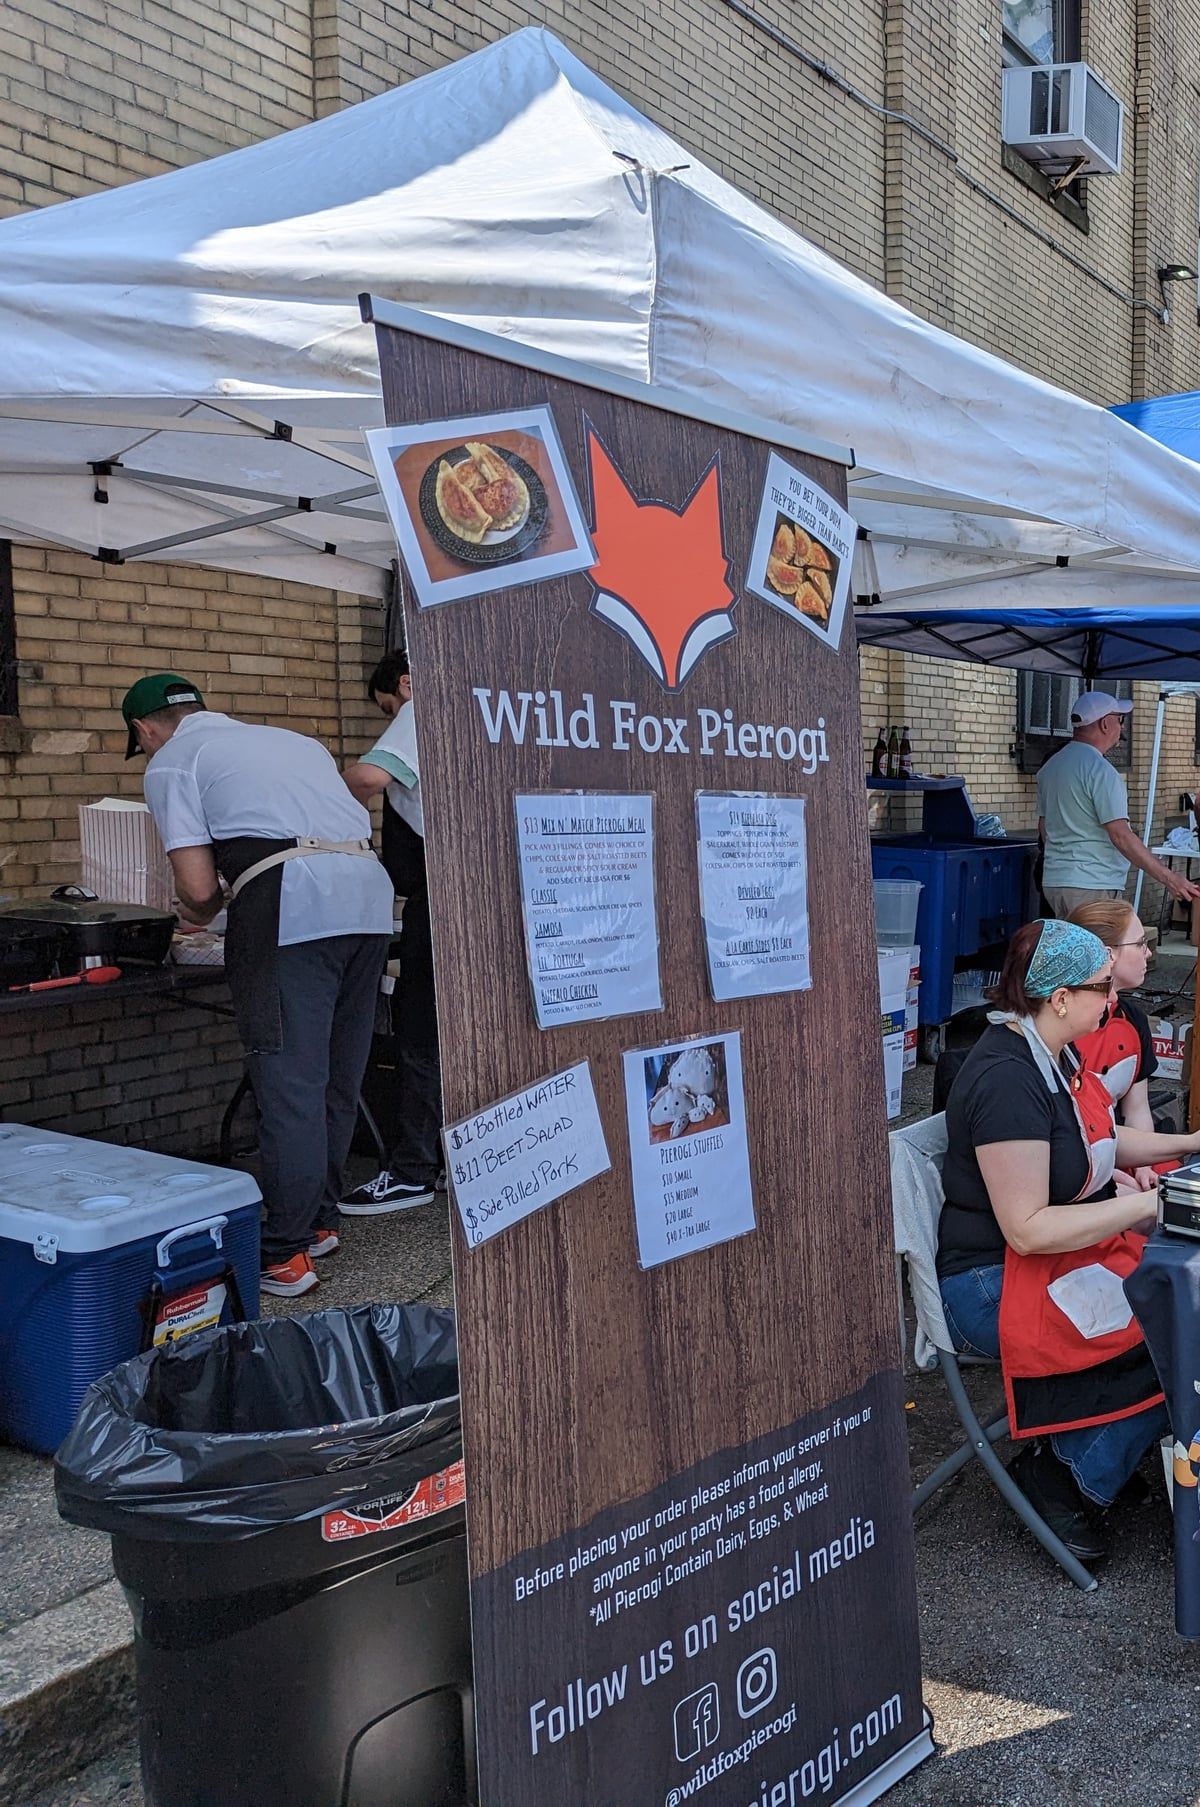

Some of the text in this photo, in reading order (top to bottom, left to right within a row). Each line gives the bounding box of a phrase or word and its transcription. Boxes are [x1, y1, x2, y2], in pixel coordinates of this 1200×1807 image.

[789, 476, 802, 496] YOU
[802, 487, 814, 505] BET
[770, 486, 796, 515] THEY'RE
[818, 521, 832, 543] THAN
[472, 687, 830, 774] Wild Fox Pierogi
[524, 816, 538, 836] $13
[531, 888, 558, 903] CLASSIC
[534, 922, 562, 937] SAMOSA
[569, 984, 598, 1000] CHICKEN
[451, 1072, 576, 1150] $1 Bottled WATER
[454, 1116, 574, 1186] $11 BEET SALAD
[660, 1133, 724, 1166] PIEROGI STUFFIES
[662, 1168, 692, 1188] $10 SMALL
[478, 1198, 504, 1222] Side
[501, 1171, 540, 1208] Pulled
[664, 1186, 699, 1207] $15 MEDIUM
[665, 1206, 694, 1226] $20 LARGE
[695, 1220, 710, 1234] LARGE
[472, 1229, 483, 1244] 6
[166, 1296, 206, 1315] Rubbermaid
[380, 1494, 403, 1506] LIFE
[515, 1406, 872, 1601] Before placing your order please inform your server if you or
[330, 1520, 348, 1534] 32
[593, 1460, 824, 1594] anyone in your party has a food allergy.
[615, 1572, 662, 1614] Pierogi
[665, 1546, 713, 1586] Contain
[716, 1530, 747, 1560] Dairy,
[750, 1513, 781, 1540] Eggs,
[784, 1501, 794, 1522] &
[796, 1482, 829, 1514] Wheat
[530, 1516, 876, 1756] Follow us on social media
[665, 1702, 798, 1807] @wildfoxpierogi
